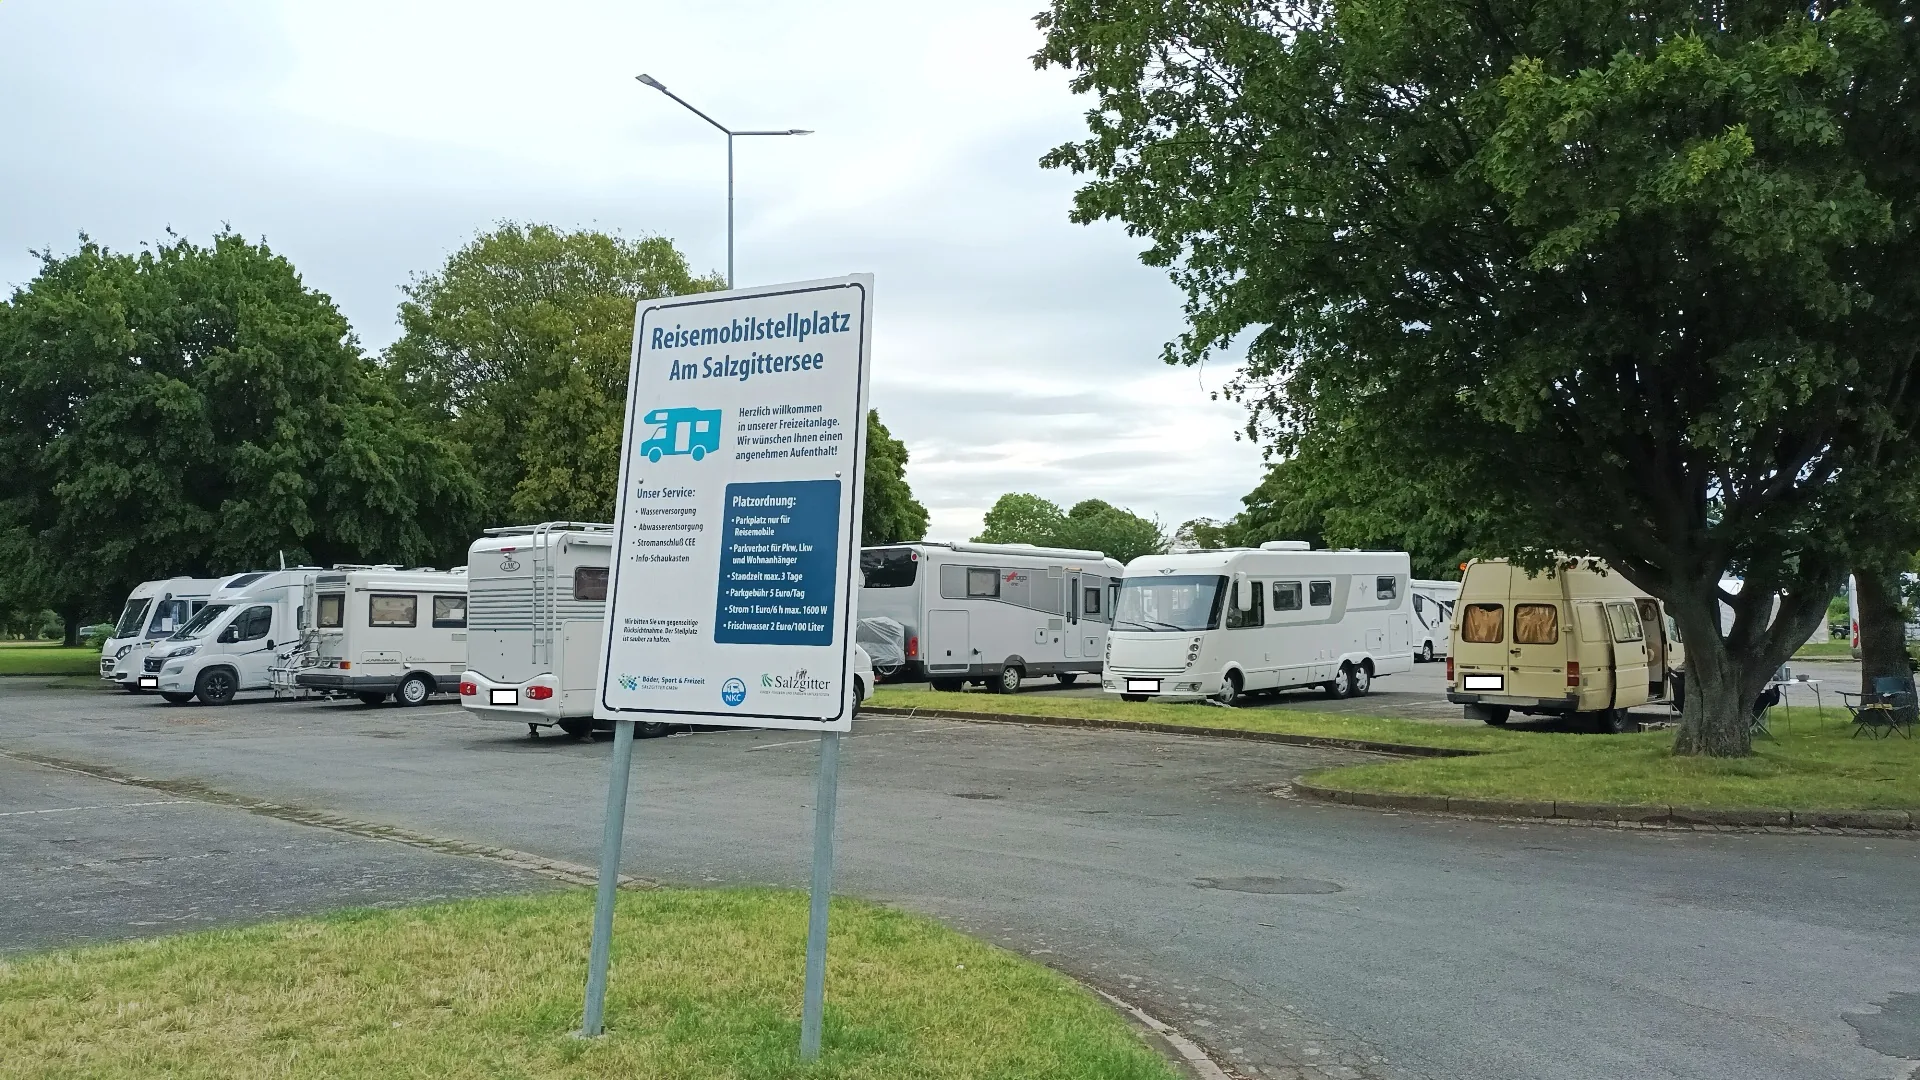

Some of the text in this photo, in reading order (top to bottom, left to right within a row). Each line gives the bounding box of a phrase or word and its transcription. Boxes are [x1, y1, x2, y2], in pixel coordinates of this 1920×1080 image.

[651, 310, 850, 349] Reisemobilstellplatz
[669, 352, 824, 381] Am Salzgittersee
[739, 404, 822, 417] Herzlich willkommen
[738, 417, 840, 431] in unserer Freizeitanlage.
[737, 431, 843, 445] Wir wünschen Ihnen einen
[736, 445, 838, 462] angenehmen Aufenthalt!
[637, 486, 696, 499] Unser Service:
[732, 495, 797, 509] Platzordnung:
[640, 507, 697, 517] Wasserversorgung
[735, 515, 767, 526] Parkplatz
[780, 515, 791, 524] für
[638, 523, 704, 532] Abwasserentsorgung
[734, 527, 775, 536] Reisemobile
[637, 538, 696, 547] Stromanschluß CEE
[733, 543, 813, 553] Parkverbot für Pkw, Lkw
[636, 553, 690, 562] Info-Schaukasten
[732, 555, 798, 566] und Wohnanhänger
[731, 572, 803, 582] Standzeit max. 3 Tage
[730, 588, 805, 599] Parkgebühr 5 Euro/Tag
[728, 605, 749, 614] Strom
[750, 605, 754, 613] 1
[755, 605, 778, 614] Euro/6
[778, 605, 783, 614] h
[802, 606, 820, 614] 1600
[820, 606, 828, 614] W
[727, 621, 824, 632] Frischwasser 2 Euro/100 Liter
[661, 676, 677, 684] Sport
[683, 677, 705, 685] Freizeit
[774, 675, 831, 692] Salzgitter
[725, 694, 742, 702] NKC
